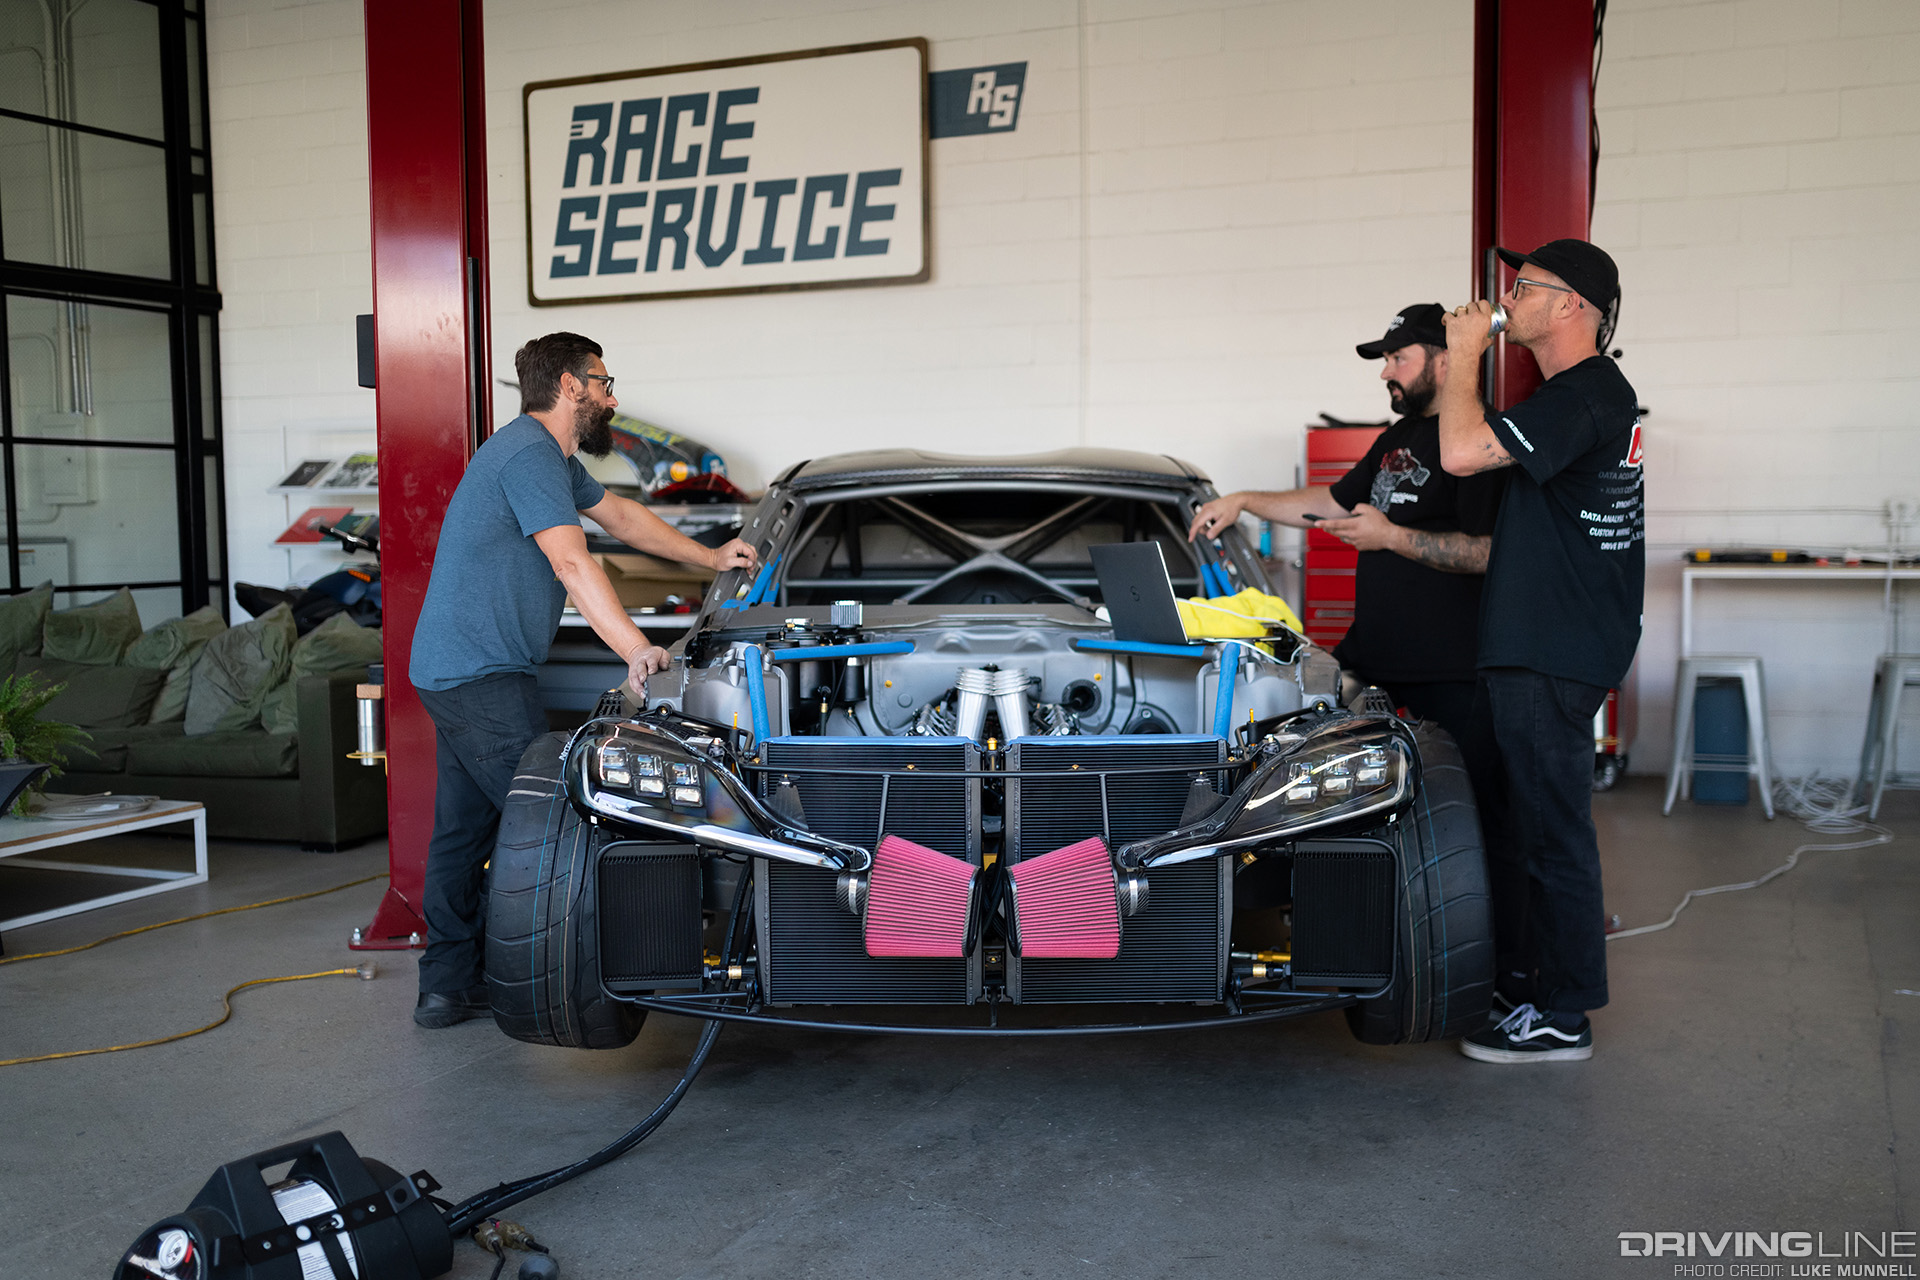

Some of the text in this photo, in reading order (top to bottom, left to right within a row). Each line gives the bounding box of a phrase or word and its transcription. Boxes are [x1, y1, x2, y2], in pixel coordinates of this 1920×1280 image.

[966, 71, 1019, 127] RS
[562, 87, 760, 189] RACE
[549, 168, 902, 279] SERVICE
[1580, 510, 1602, 523] DATA
[1589, 527, 1615, 537] CUSTOM
[1600, 542, 1617, 550] DRIVE
